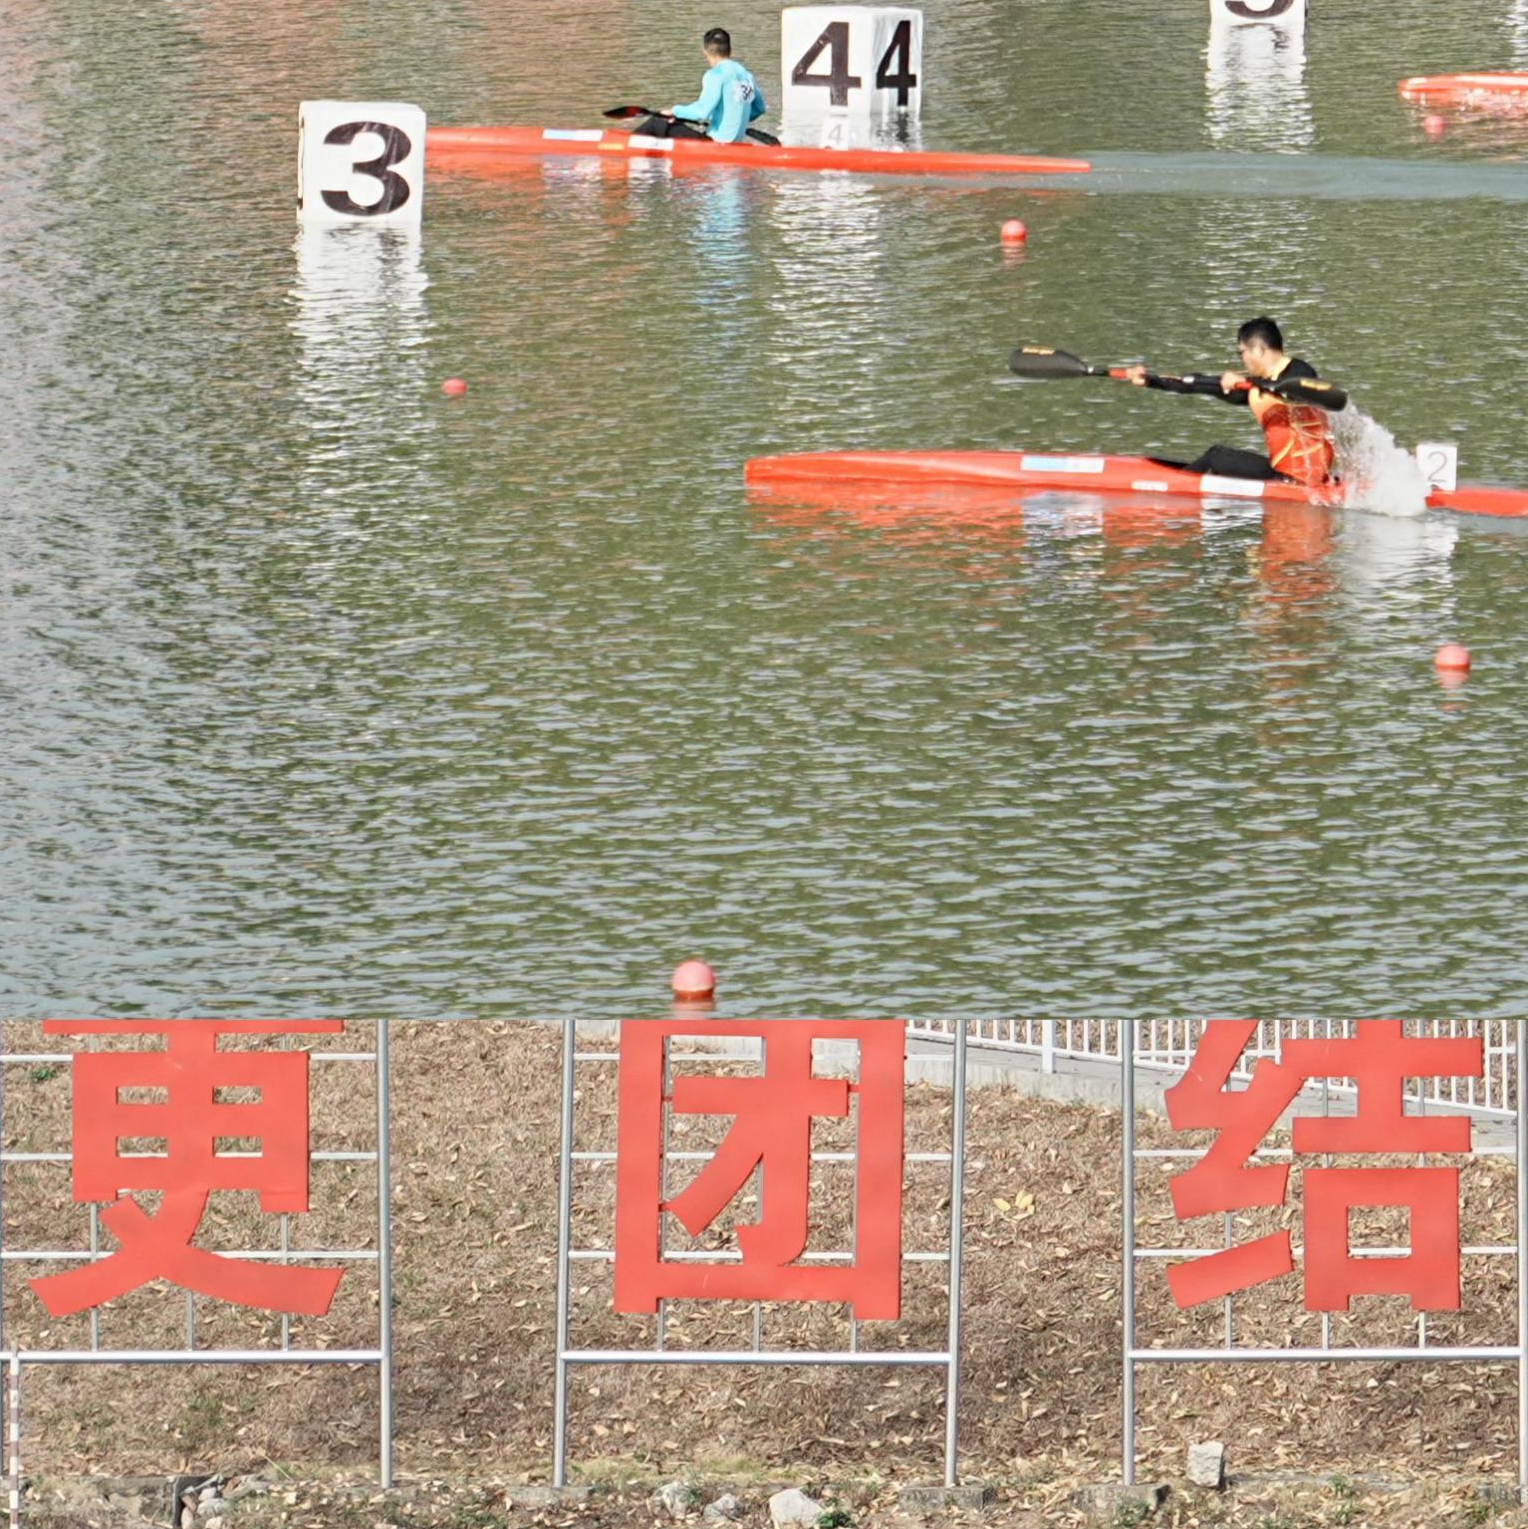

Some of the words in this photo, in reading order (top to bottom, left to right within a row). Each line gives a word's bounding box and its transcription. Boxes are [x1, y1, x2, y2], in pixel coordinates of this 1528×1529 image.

[792, 21, 861, 106] 4
[876, 20, 917, 106] 4
[321, 121, 412, 216] 3
[828, 123, 843, 146] 4
[1428, 452, 1449, 484] 2
[29, 1020, 1485, 1321] 更团结
